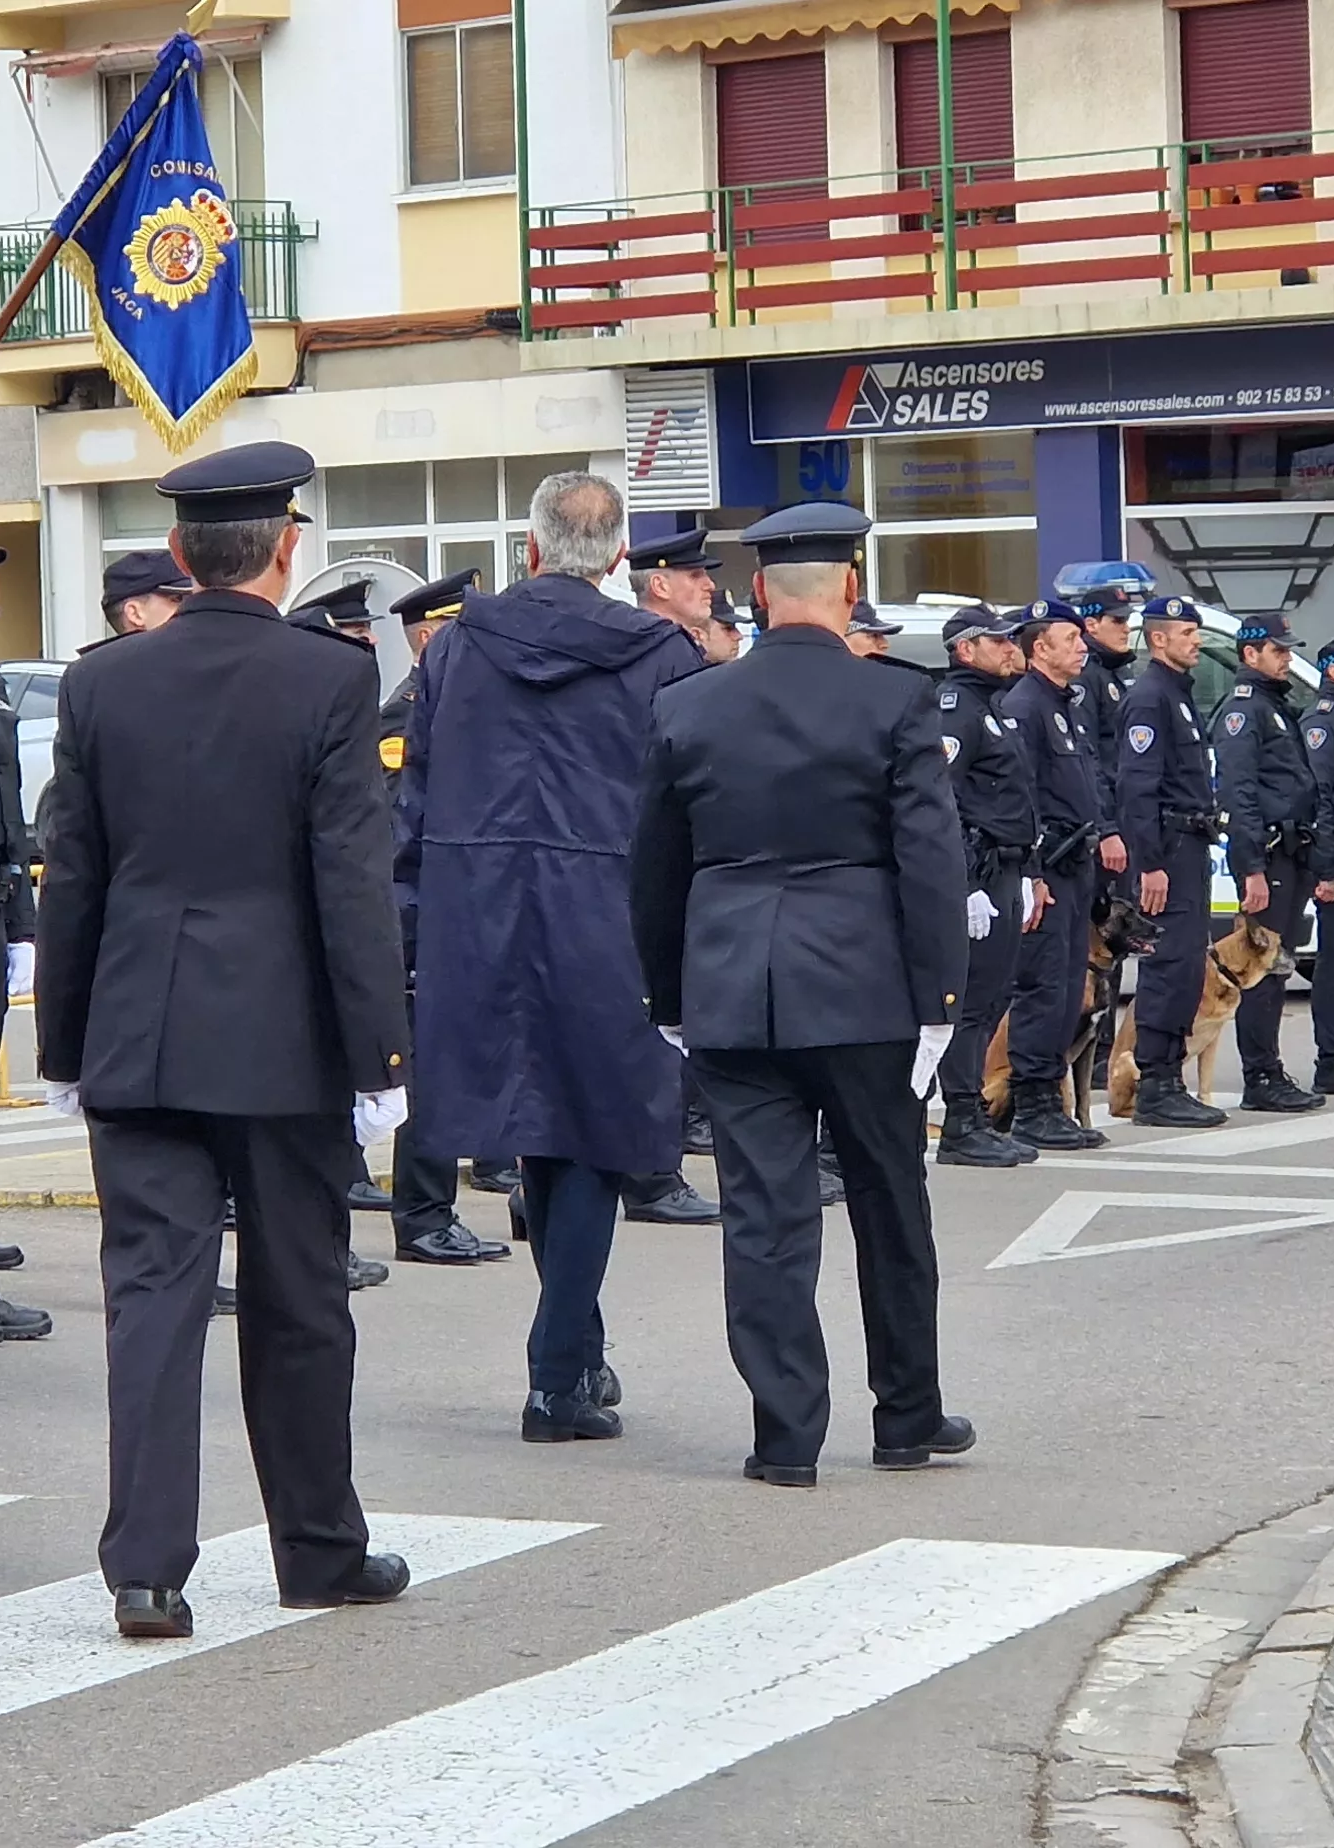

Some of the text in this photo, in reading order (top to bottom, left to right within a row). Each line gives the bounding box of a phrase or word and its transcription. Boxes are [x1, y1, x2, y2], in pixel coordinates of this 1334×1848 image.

[111, 286, 143, 320] JACA
[901, 359, 1045, 388] Ascensores
[893, 390, 990, 425] SALES
[1044, 394, 1225, 417] www.ascensoressales.com
[1236, 389, 1262, 406] 902
[1266, 388, 1282, 404] 15
[1284, 387, 1302, 403] 83
[1304, 386, 1322, 402] 53
[798, 440, 851, 492] 50
